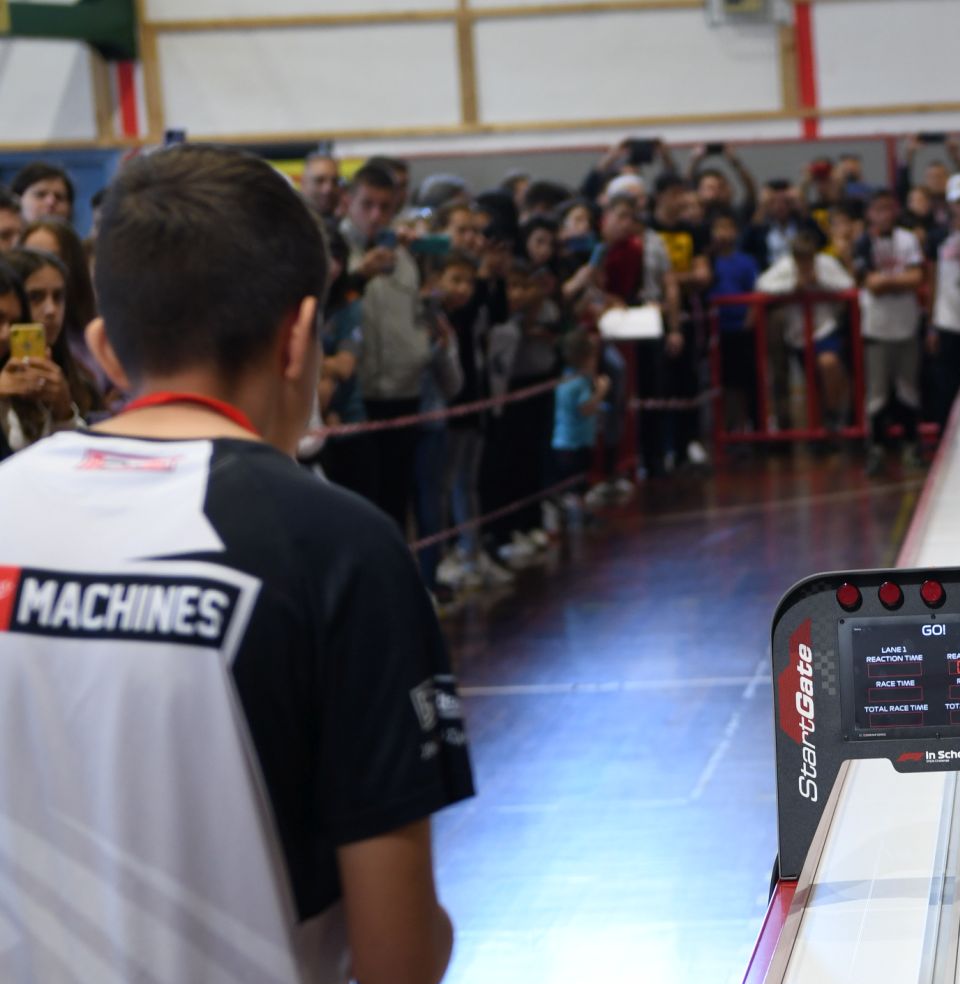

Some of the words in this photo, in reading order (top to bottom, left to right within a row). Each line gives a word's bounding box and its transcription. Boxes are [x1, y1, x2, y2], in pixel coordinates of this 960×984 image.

[17, 577, 229, 638] MACHINES
[921, 624, 946, 636] GO!
[795, 643, 818, 802] StartGate
